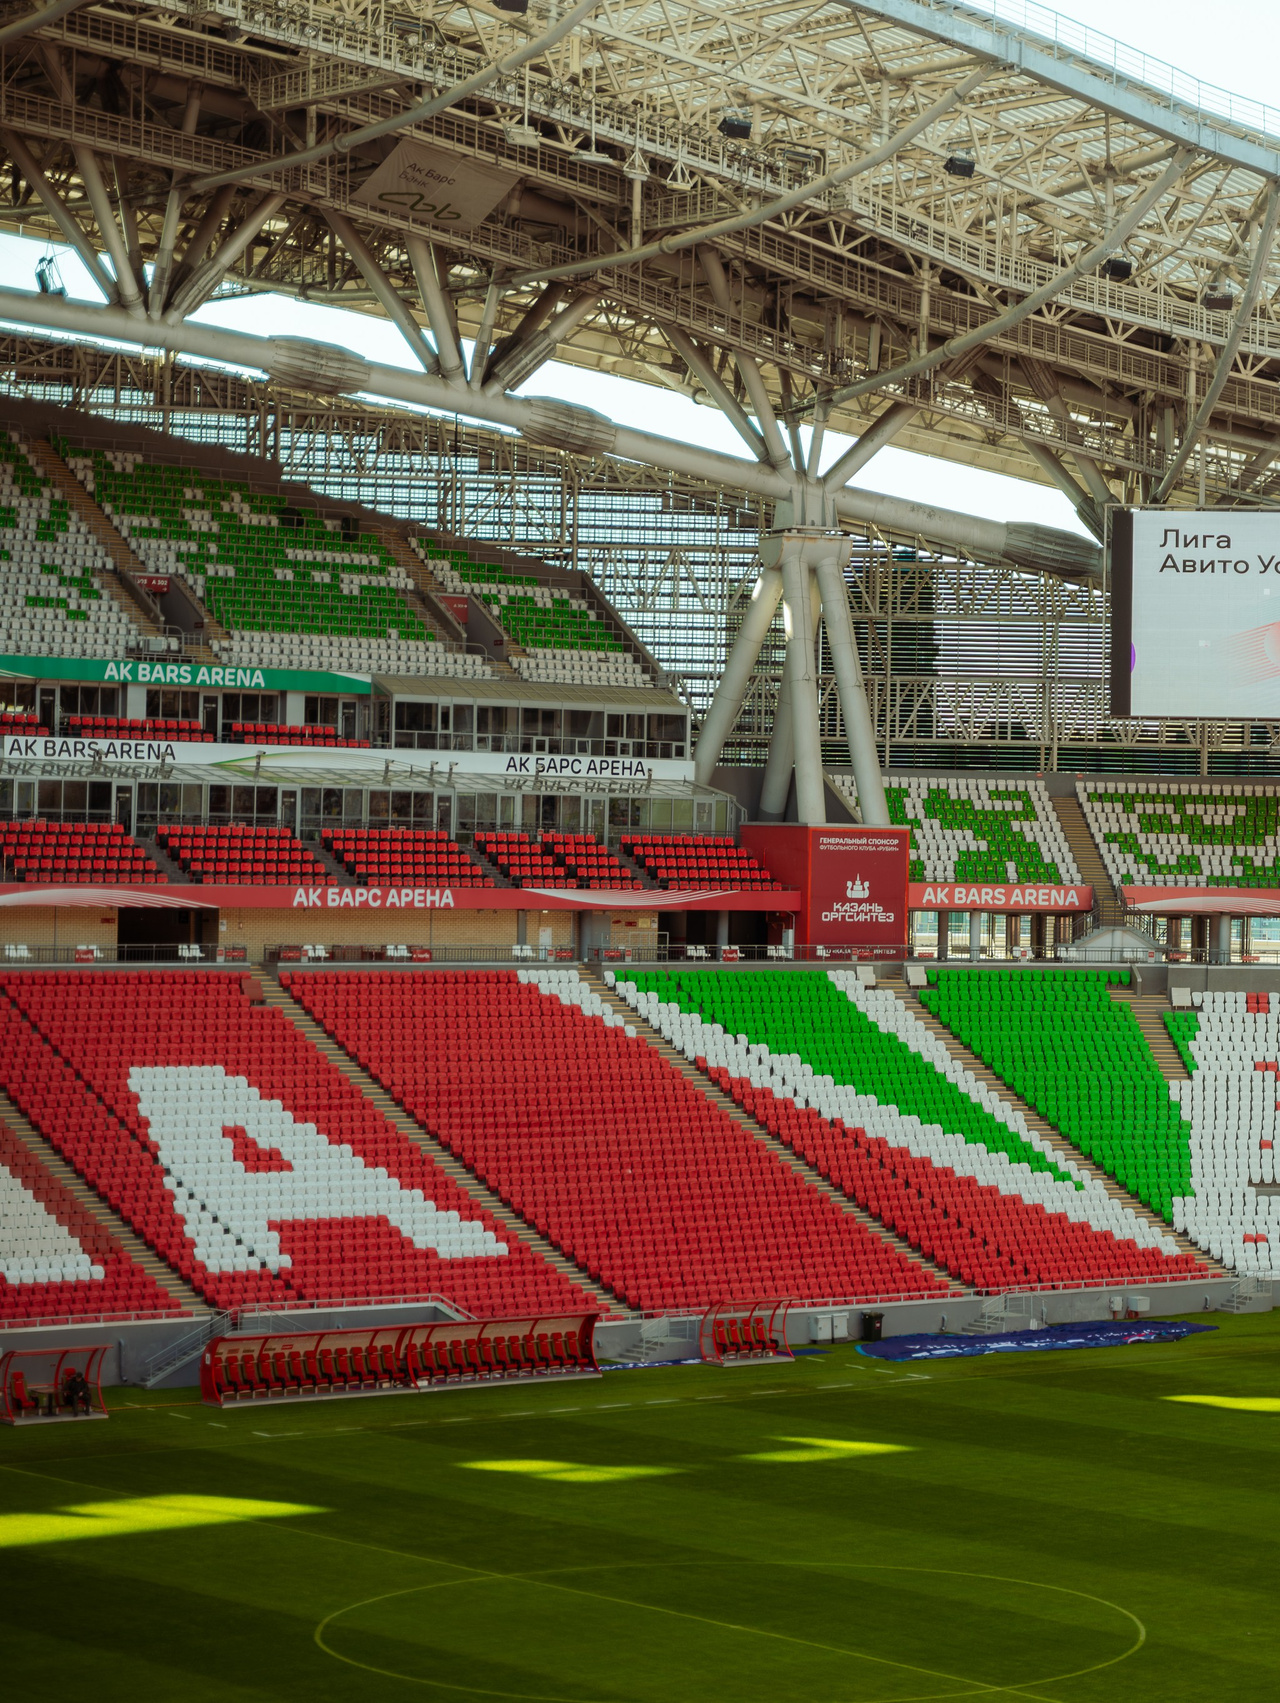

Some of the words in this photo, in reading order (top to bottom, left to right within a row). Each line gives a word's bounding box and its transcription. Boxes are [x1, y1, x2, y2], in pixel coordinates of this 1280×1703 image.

[398, 171, 430, 188] Банк
[406, 162, 425, 175] Ак
[425, 169, 456, 186] Барс
[1160, 529, 1231, 548] Лига
[1159, 554, 1250, 574] Авито
[104, 662, 133, 680] AK
[138, 664, 192, 684] BARS
[196, 667, 265, 688] ARENA
[8, 739, 37, 756] AK
[44, 740, 99, 759] BARS
[105, 742, 176, 761] ARENA
[506, 757, 530, 773] АК
[536, 758, 582, 774] БАРС
[587, 760, 645, 776] АРЕНА
[820, 837, 867, 845] ГЕНЕРАЛЬНЫЙ
[293, 888, 322, 907] АК
[327, 888, 381, 907] БАРС
[386, 889, 454, 907] АРЕНА
[922, 887, 949, 904] AK
[954, 887, 1006, 905] BARS
[1010, 888, 1079, 906] ARENA
[833, 902, 883, 912] КАЗАНЬ
[821, 912, 895, 922] ОРГСИНТЕЗ
